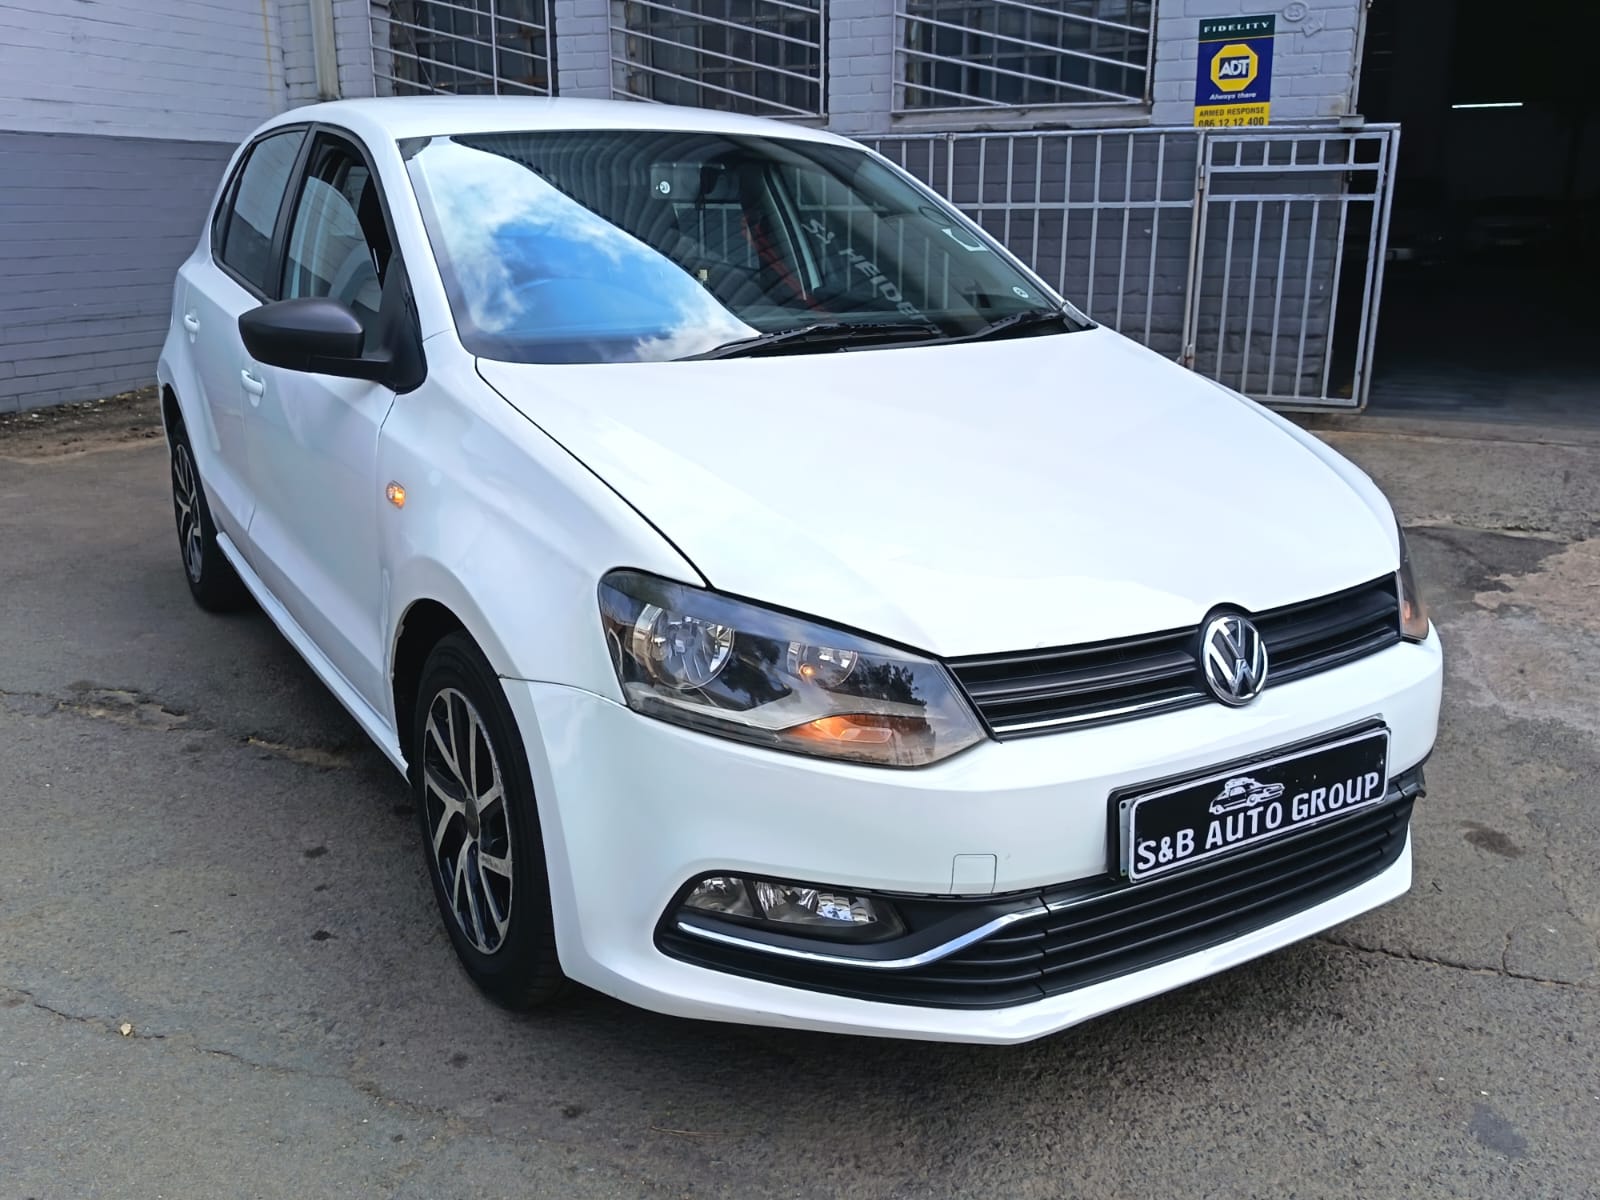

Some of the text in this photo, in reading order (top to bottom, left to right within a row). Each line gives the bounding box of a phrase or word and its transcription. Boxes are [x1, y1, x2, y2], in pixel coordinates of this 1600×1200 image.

[1204, 22, 1269, 32] FIDELITY
[1219, 59, 1250, 77] ADT
[1199, 106, 1265, 117] ARMED RESPONSE
[1219, 118, 1230, 127] 12
[1233, 117, 1244, 127] 12
[1247, 116, 1265, 126] 400
[1137, 771, 1380, 870] S&B AUTO GROUP
